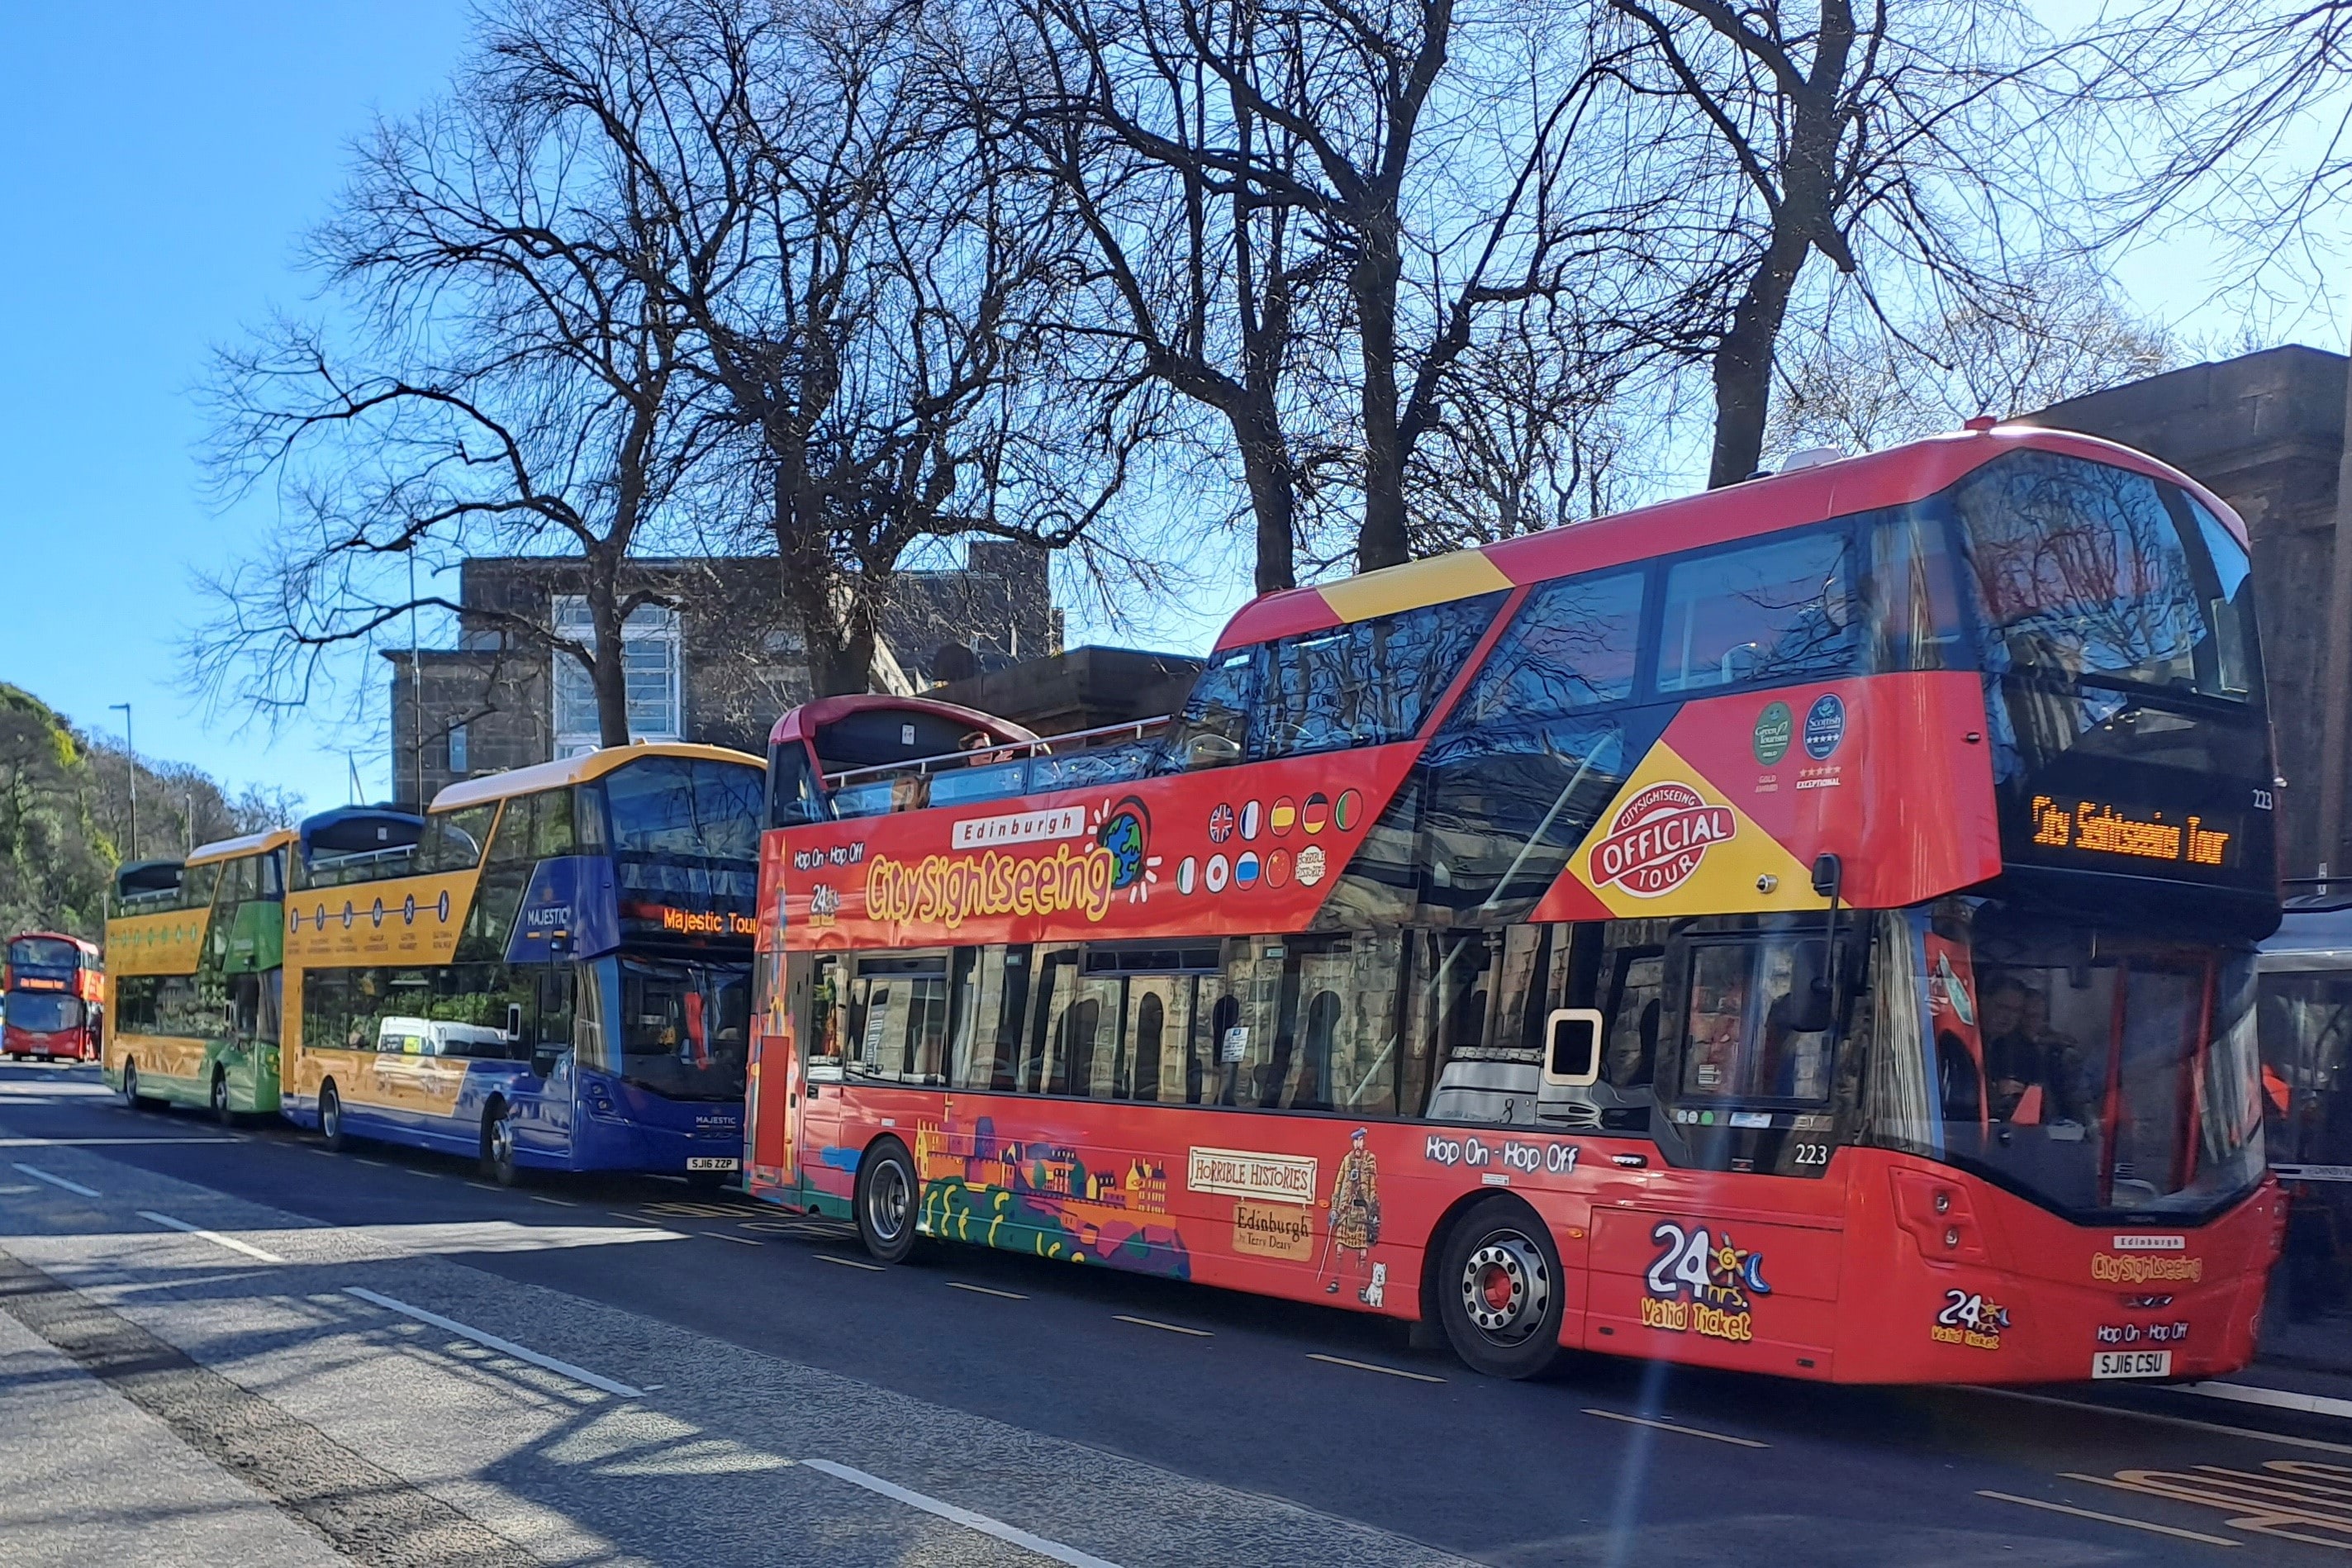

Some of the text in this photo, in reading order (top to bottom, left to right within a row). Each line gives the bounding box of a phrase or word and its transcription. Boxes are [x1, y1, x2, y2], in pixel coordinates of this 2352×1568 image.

[1756, 725, 1778, 736] Green
[1760, 734, 1788, 744] Tourism
[1796, 777, 1841, 790] EXCEPTIONAL
[1620, 789, 1696, 827] CITYSIGHTSEEING
[963, 812, 1071, 841] Edinburgh
[794, 842, 864, 871] Hop On Hop Off
[1603, 810, 1727, 875] OFFICIAL
[1638, 853, 1694, 889] TOUR
[810, 883, 827, 914] 24
[867, 843, 1114, 929] CitySightseeing
[527, 907, 568, 926] MAJESTIC
[663, 908, 723, 934] Majestic
[696, 1116, 736, 1124] MAJESTIC
[691, 1159, 733, 1169] SJ16 ZZP
[1426, 1135, 1461, 1166] Hop
[1465, 1138, 1489, 1165] On
[1504, 1142, 1542, 1172] Hop
[1546, 1143, 1579, 1172] Off
[1794, 1143, 1828, 1165] 223
[1195, 1159, 1309, 1192] HORRIBLE HISTORIES
[1237, 1206, 1309, 1243] Edinburgh
[1246, 1232, 1267, 1246] Terry
[1269, 1235, 1292, 1251] Deary
[2120, 1238, 2179, 1247] Edinburgh
[1648, 1224, 1712, 1298] 24
[2092, 1252, 2202, 1284] CitySightseeing
[1641, 1296, 1752, 1341] Valid Ticket
[1938, 1289, 1983, 1328] 24
[1931, 1324, 1964, 1344] Valid
[2098, 1325, 2122, 1343] Hop
[2125, 1323, 2141, 1342] On
[2150, 1324, 2171, 1342] Hop
[2172, 1322, 2188, 1340] Off
[2101, 1352, 2164, 1375] SJ16 CSU
